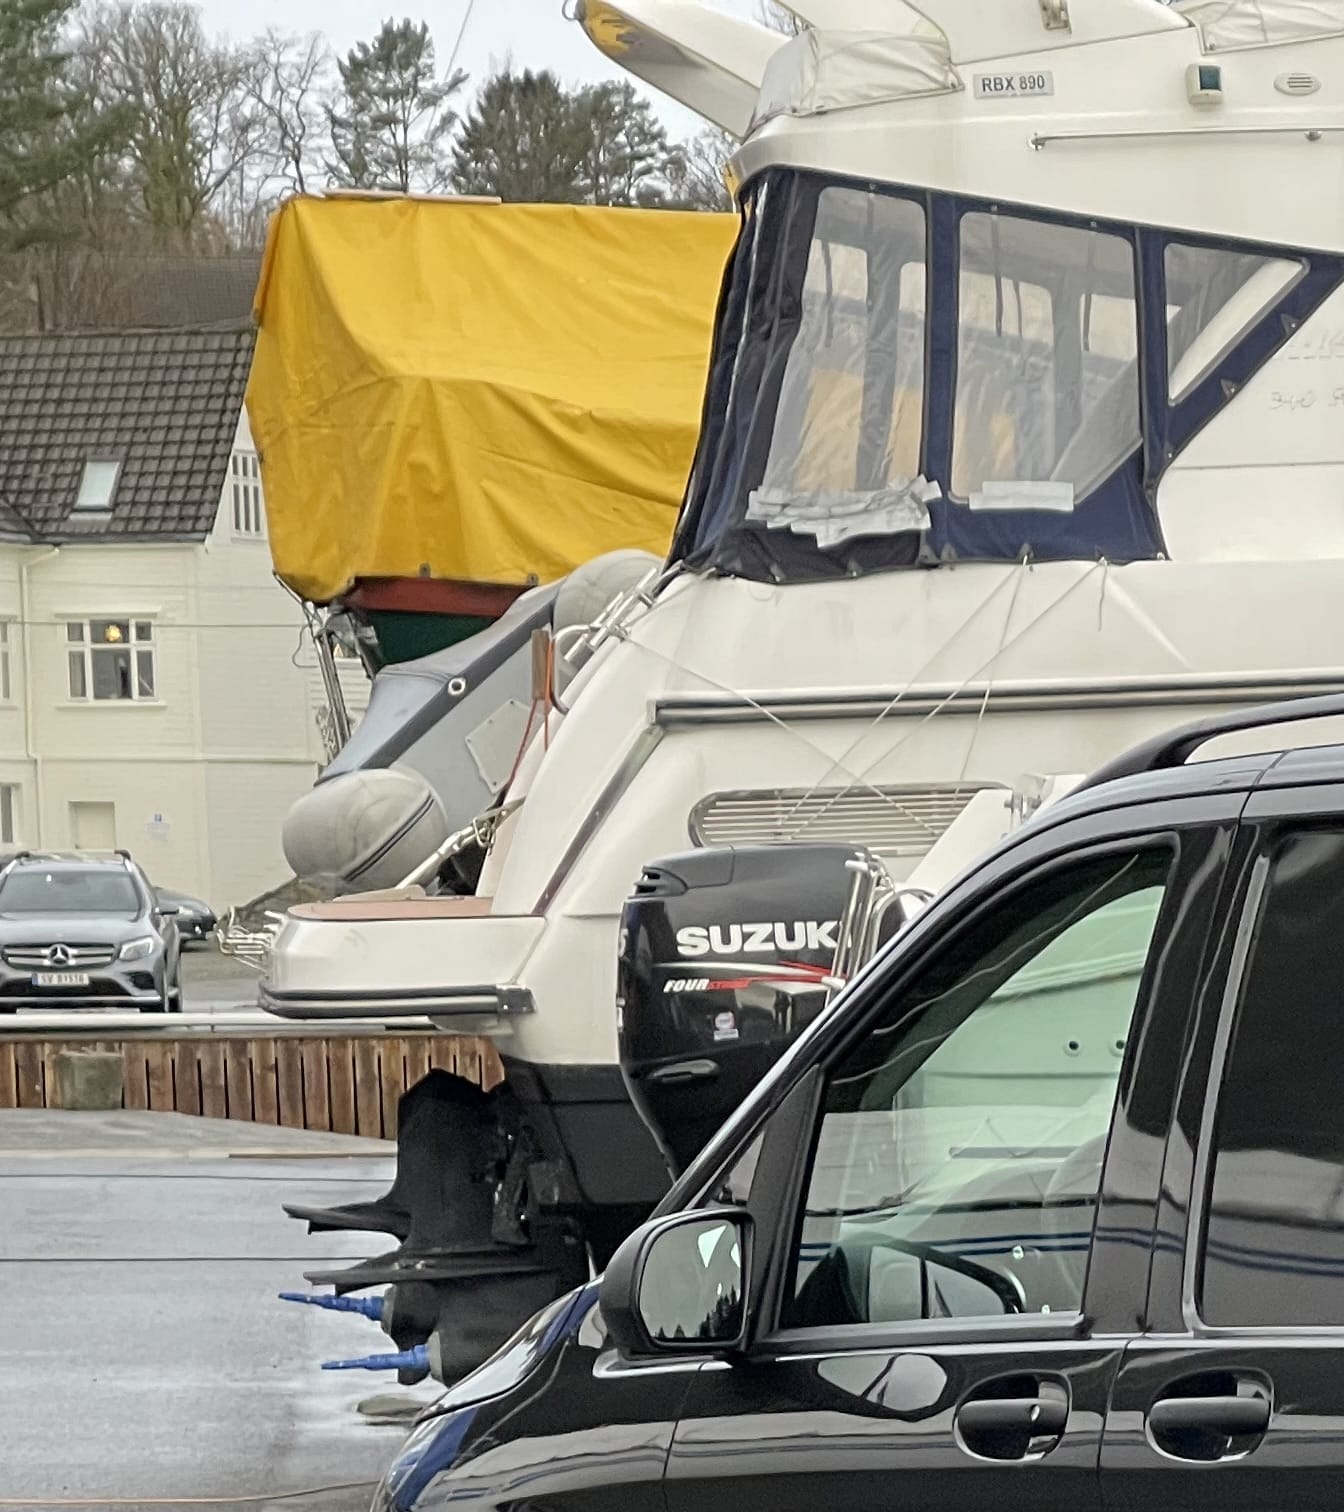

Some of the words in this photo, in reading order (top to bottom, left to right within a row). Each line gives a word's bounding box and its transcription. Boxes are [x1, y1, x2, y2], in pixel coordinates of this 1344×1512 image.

[981, 76, 1015, 92] RBX
[1019, 74, 1045, 90] 890
[663, 978, 710, 993] FOUR
